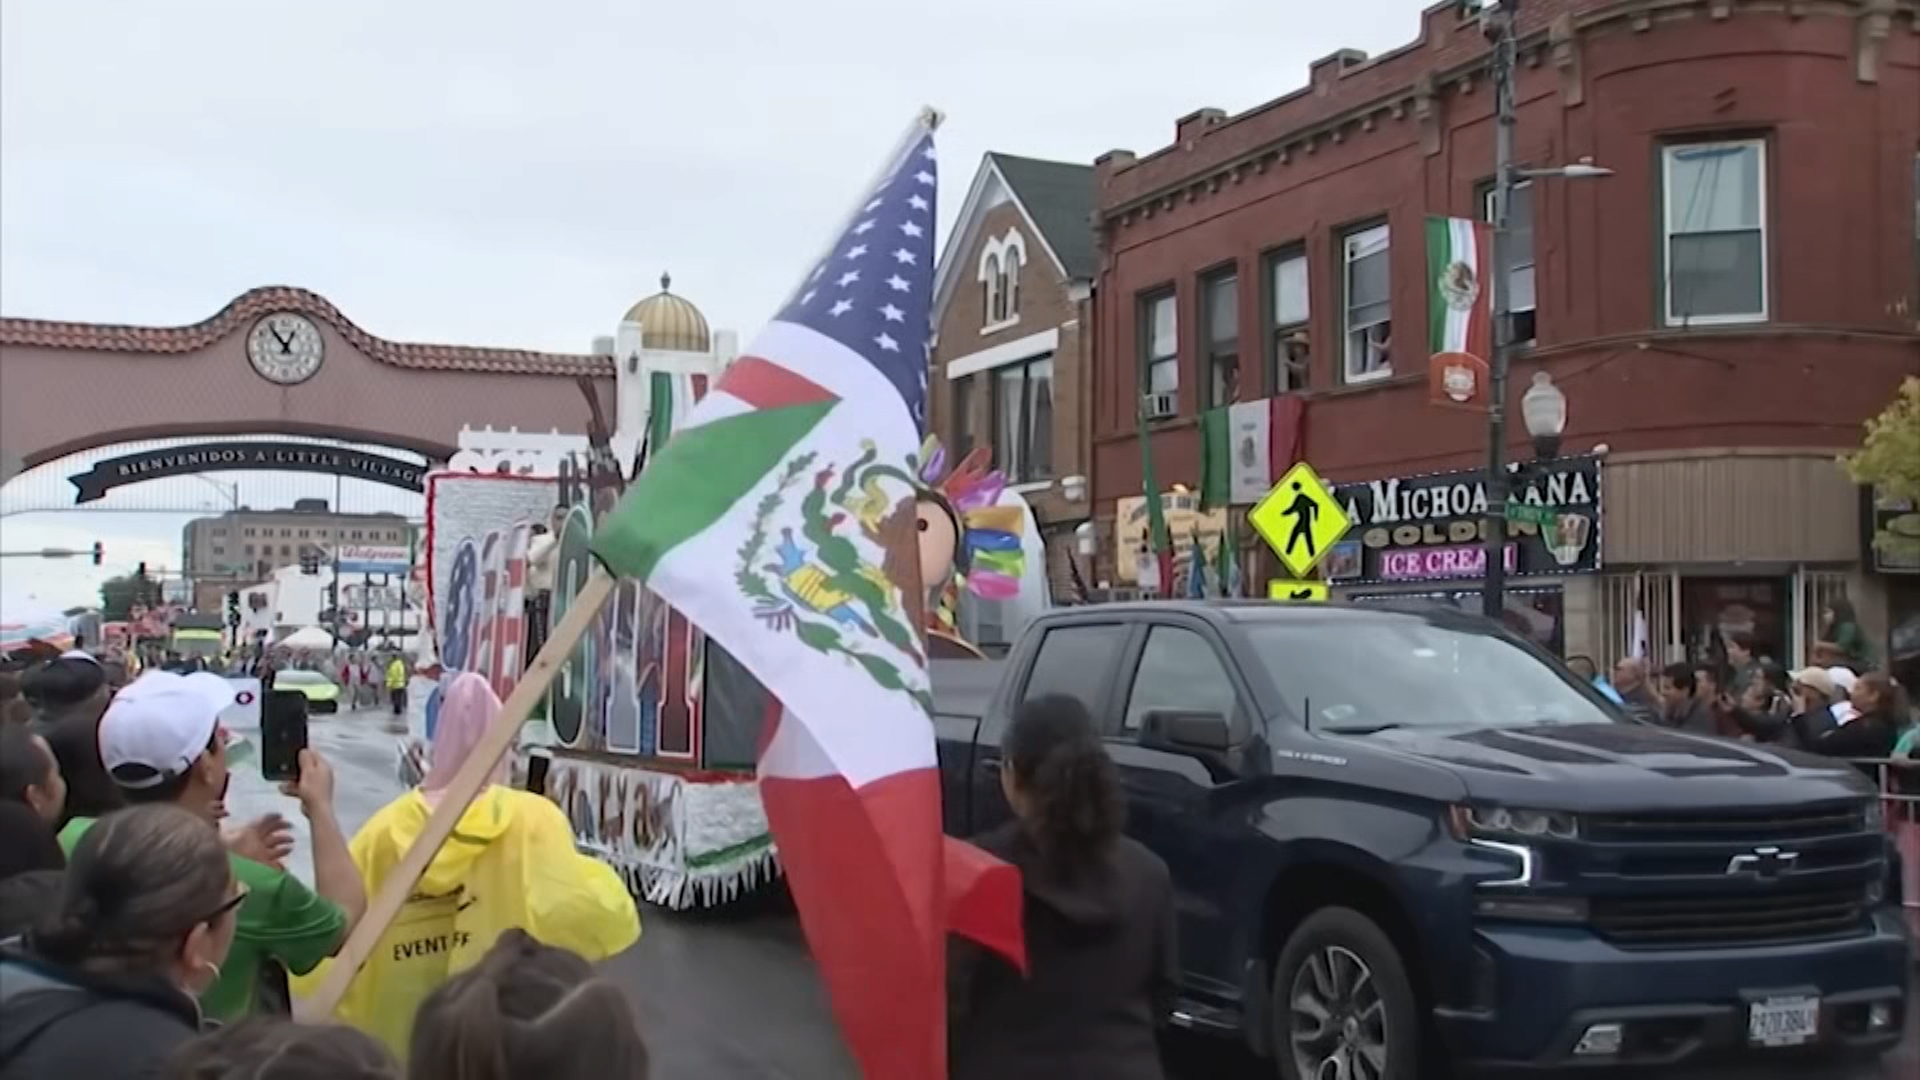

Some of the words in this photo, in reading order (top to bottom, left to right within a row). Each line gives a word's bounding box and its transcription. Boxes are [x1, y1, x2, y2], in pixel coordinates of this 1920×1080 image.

[118, 449, 246, 476] BIENVENIDOS
[255, 450, 266, 462] A
[275, 450, 340, 466] LITTLE
[1369, 471, 1592, 524] MICHOAANA
[1383, 552, 1421, 576] ICE
[393, 935, 448, 961] EVENT
